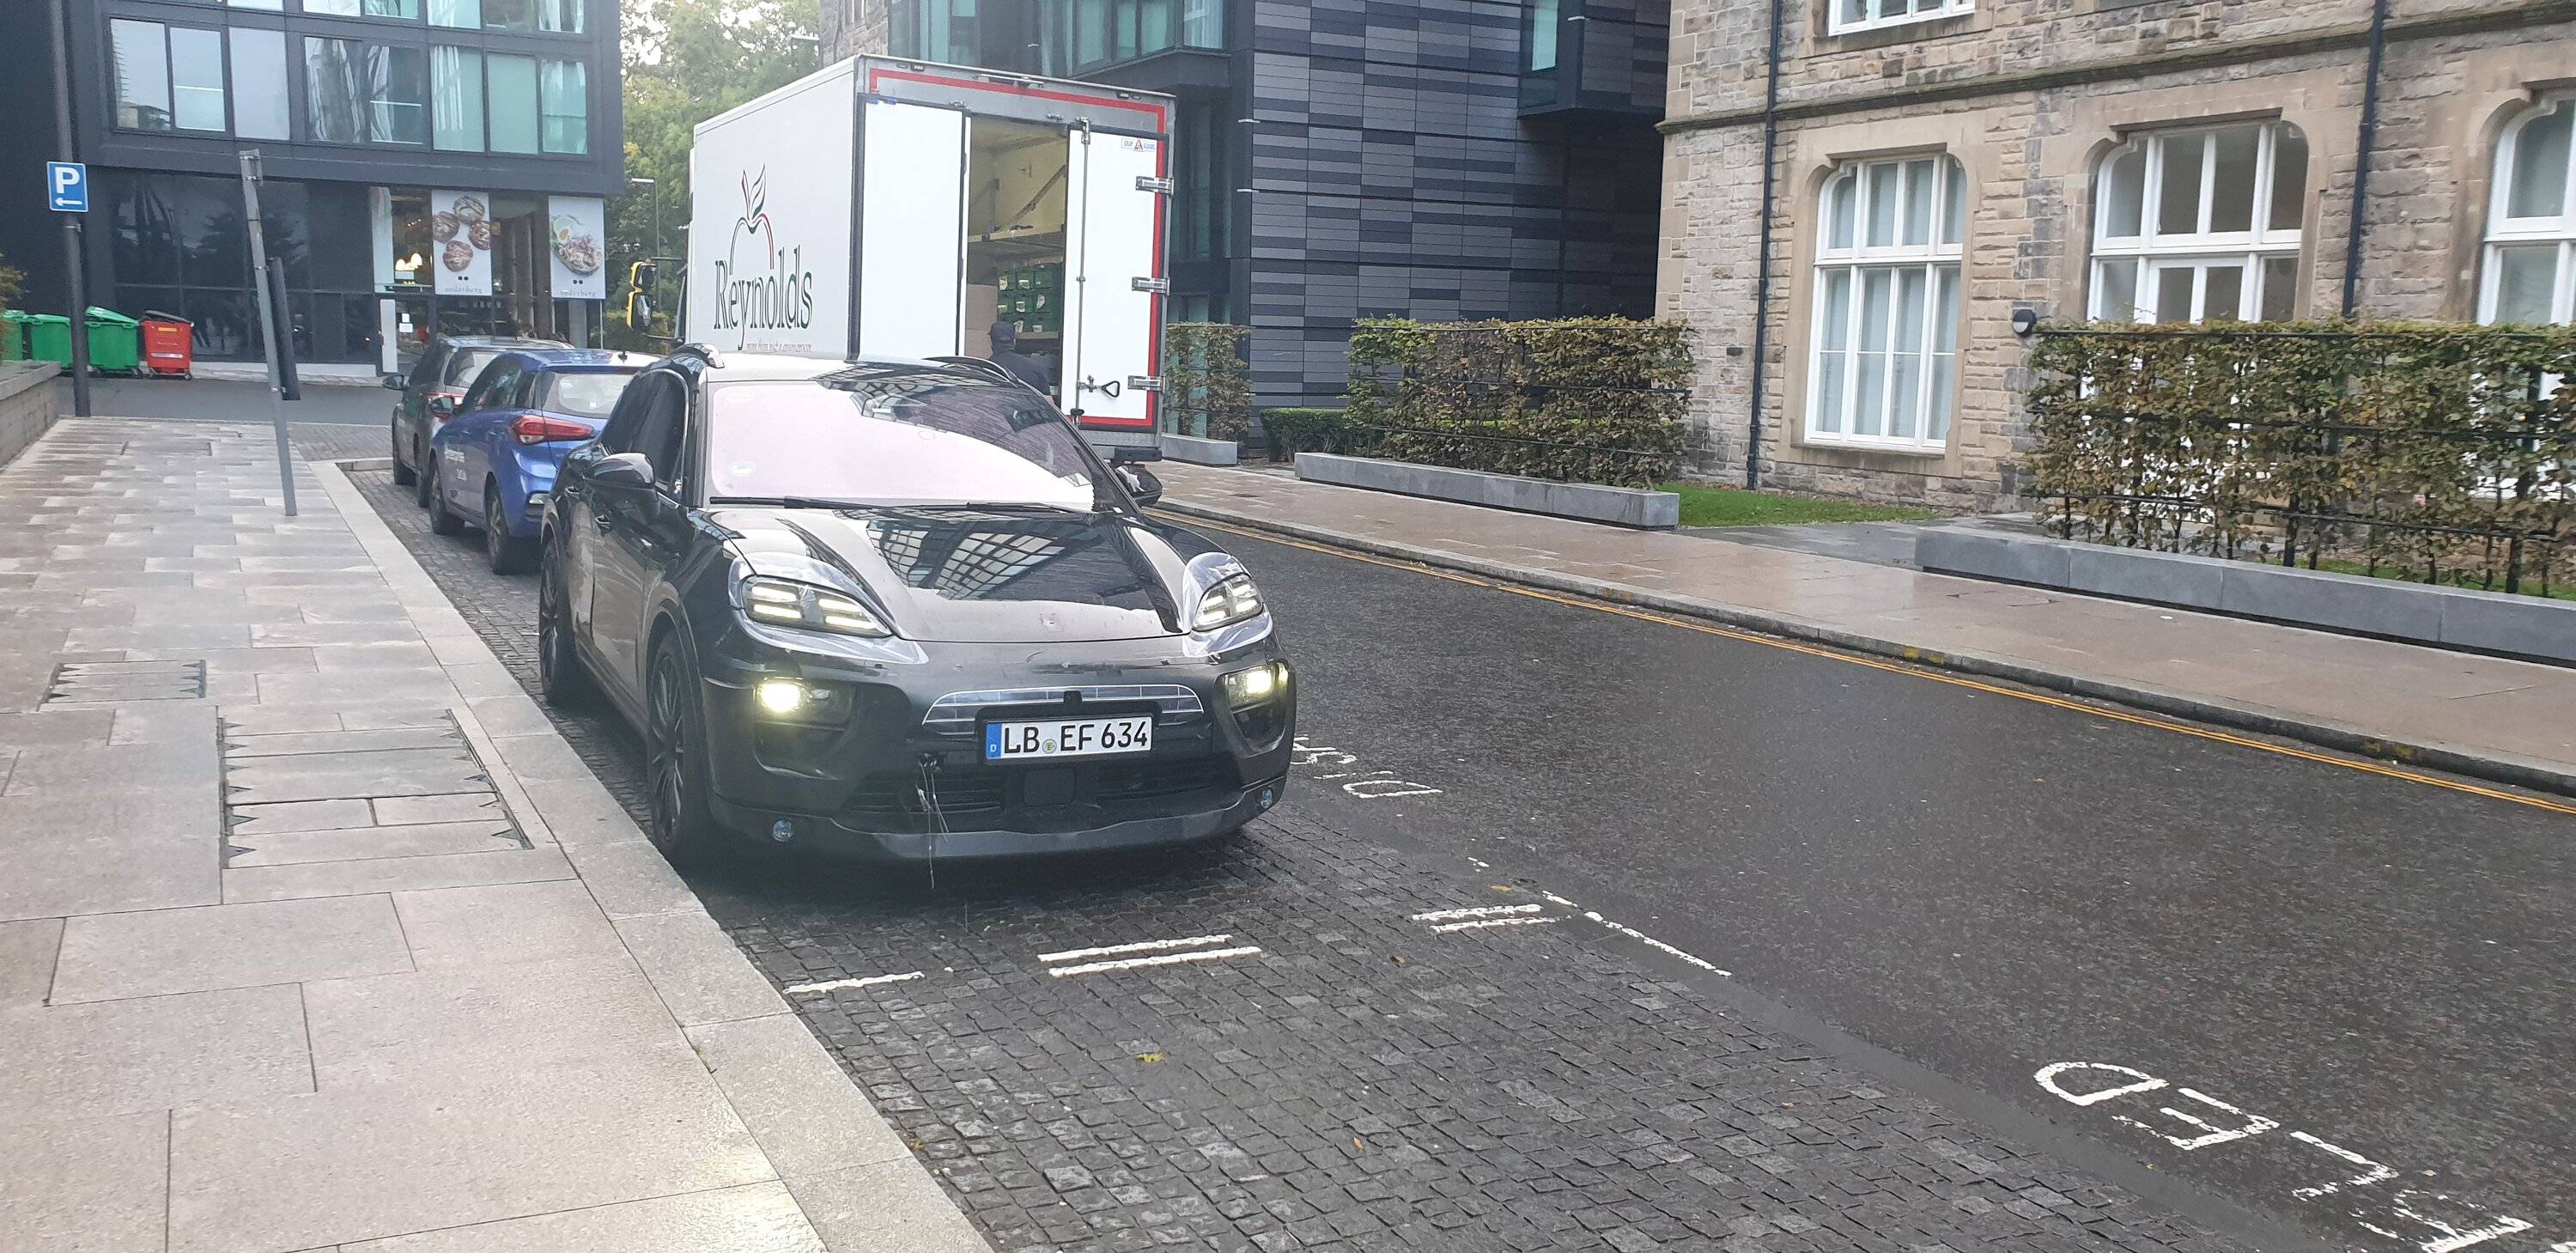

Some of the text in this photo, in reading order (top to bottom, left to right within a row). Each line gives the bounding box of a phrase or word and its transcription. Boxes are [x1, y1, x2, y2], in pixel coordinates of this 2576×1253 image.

[55, 167, 80, 194] P
[714, 245, 813, 350] Reynolds
[990, 744, 997, 752] D
[1004, 721, 1148, 753] LB EF 634
